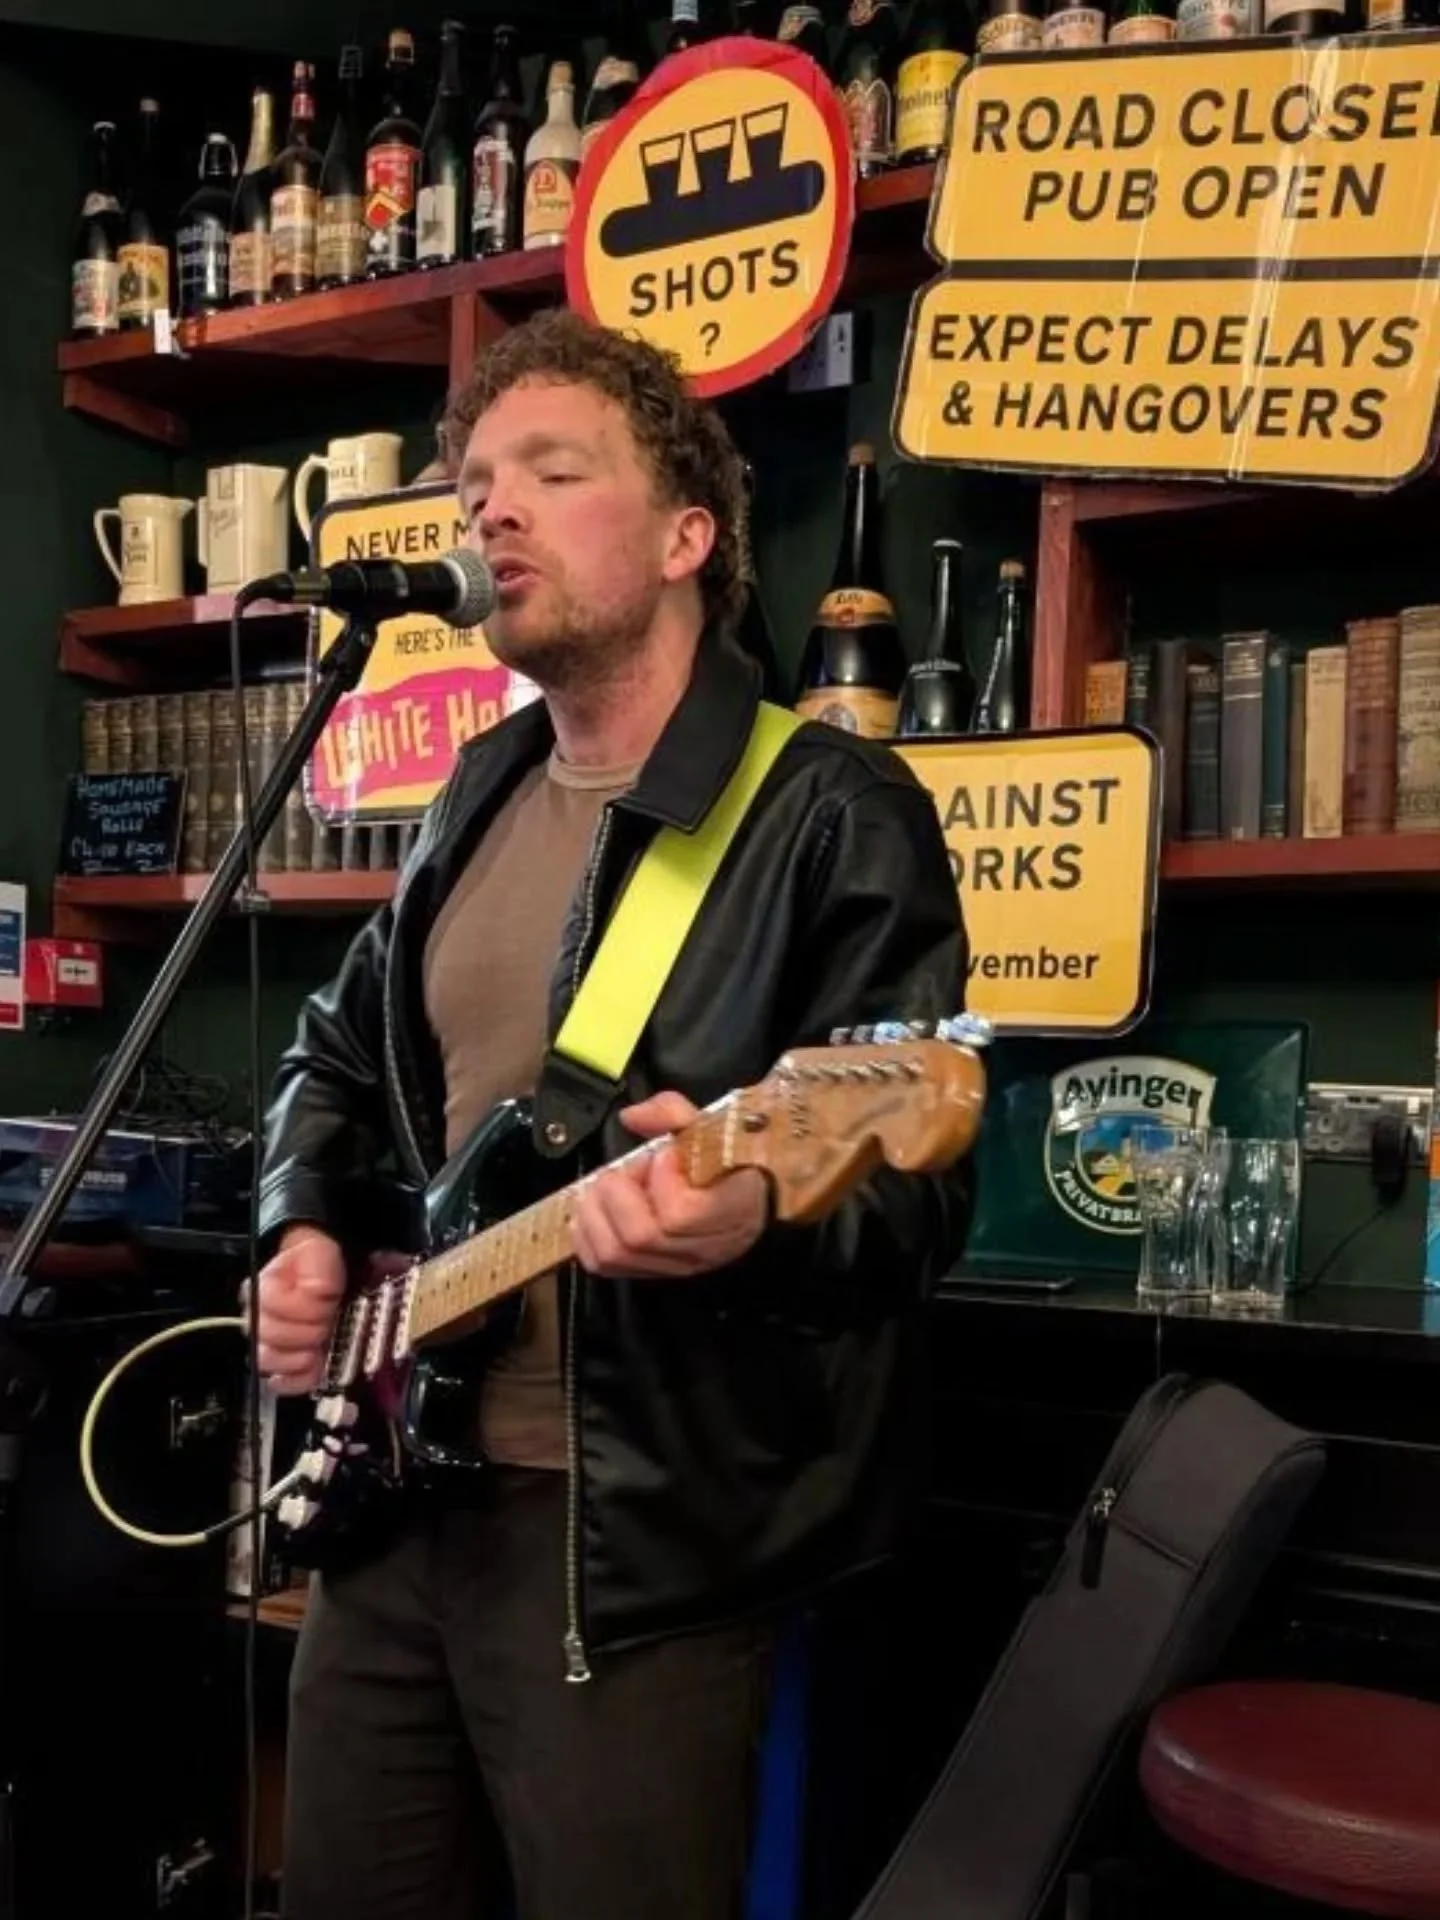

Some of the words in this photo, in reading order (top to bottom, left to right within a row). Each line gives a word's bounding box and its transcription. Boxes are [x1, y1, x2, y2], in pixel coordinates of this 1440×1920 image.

[972, 94, 1156, 152] ROAD
[1180, 80, 1440, 148] CLOSE
[1023, 169, 1157, 221] PUB
[1182, 162, 1386, 220] OPEN
[628, 239, 800, 318] SHOTS
[699, 322, 721, 357] ?
[928, 314, 1153, 365] EXPECT
[1167, 315, 1419, 367] DELAYS
[941, 380, 974, 426] &
[993, 382, 1388, 440] HANGOVERS
[347, 522, 440, 560] NEVER
[452, 521, 471, 547] M
[395, 628, 445, 656] HERE'S
[321, 695, 434, 790] WHITE
[446, 688, 512, 748] HO
[945, 777, 1120, 830] AINST
[968, 946, 1100, 979] vember
[1063, 1064, 1202, 1110] Ayinger
